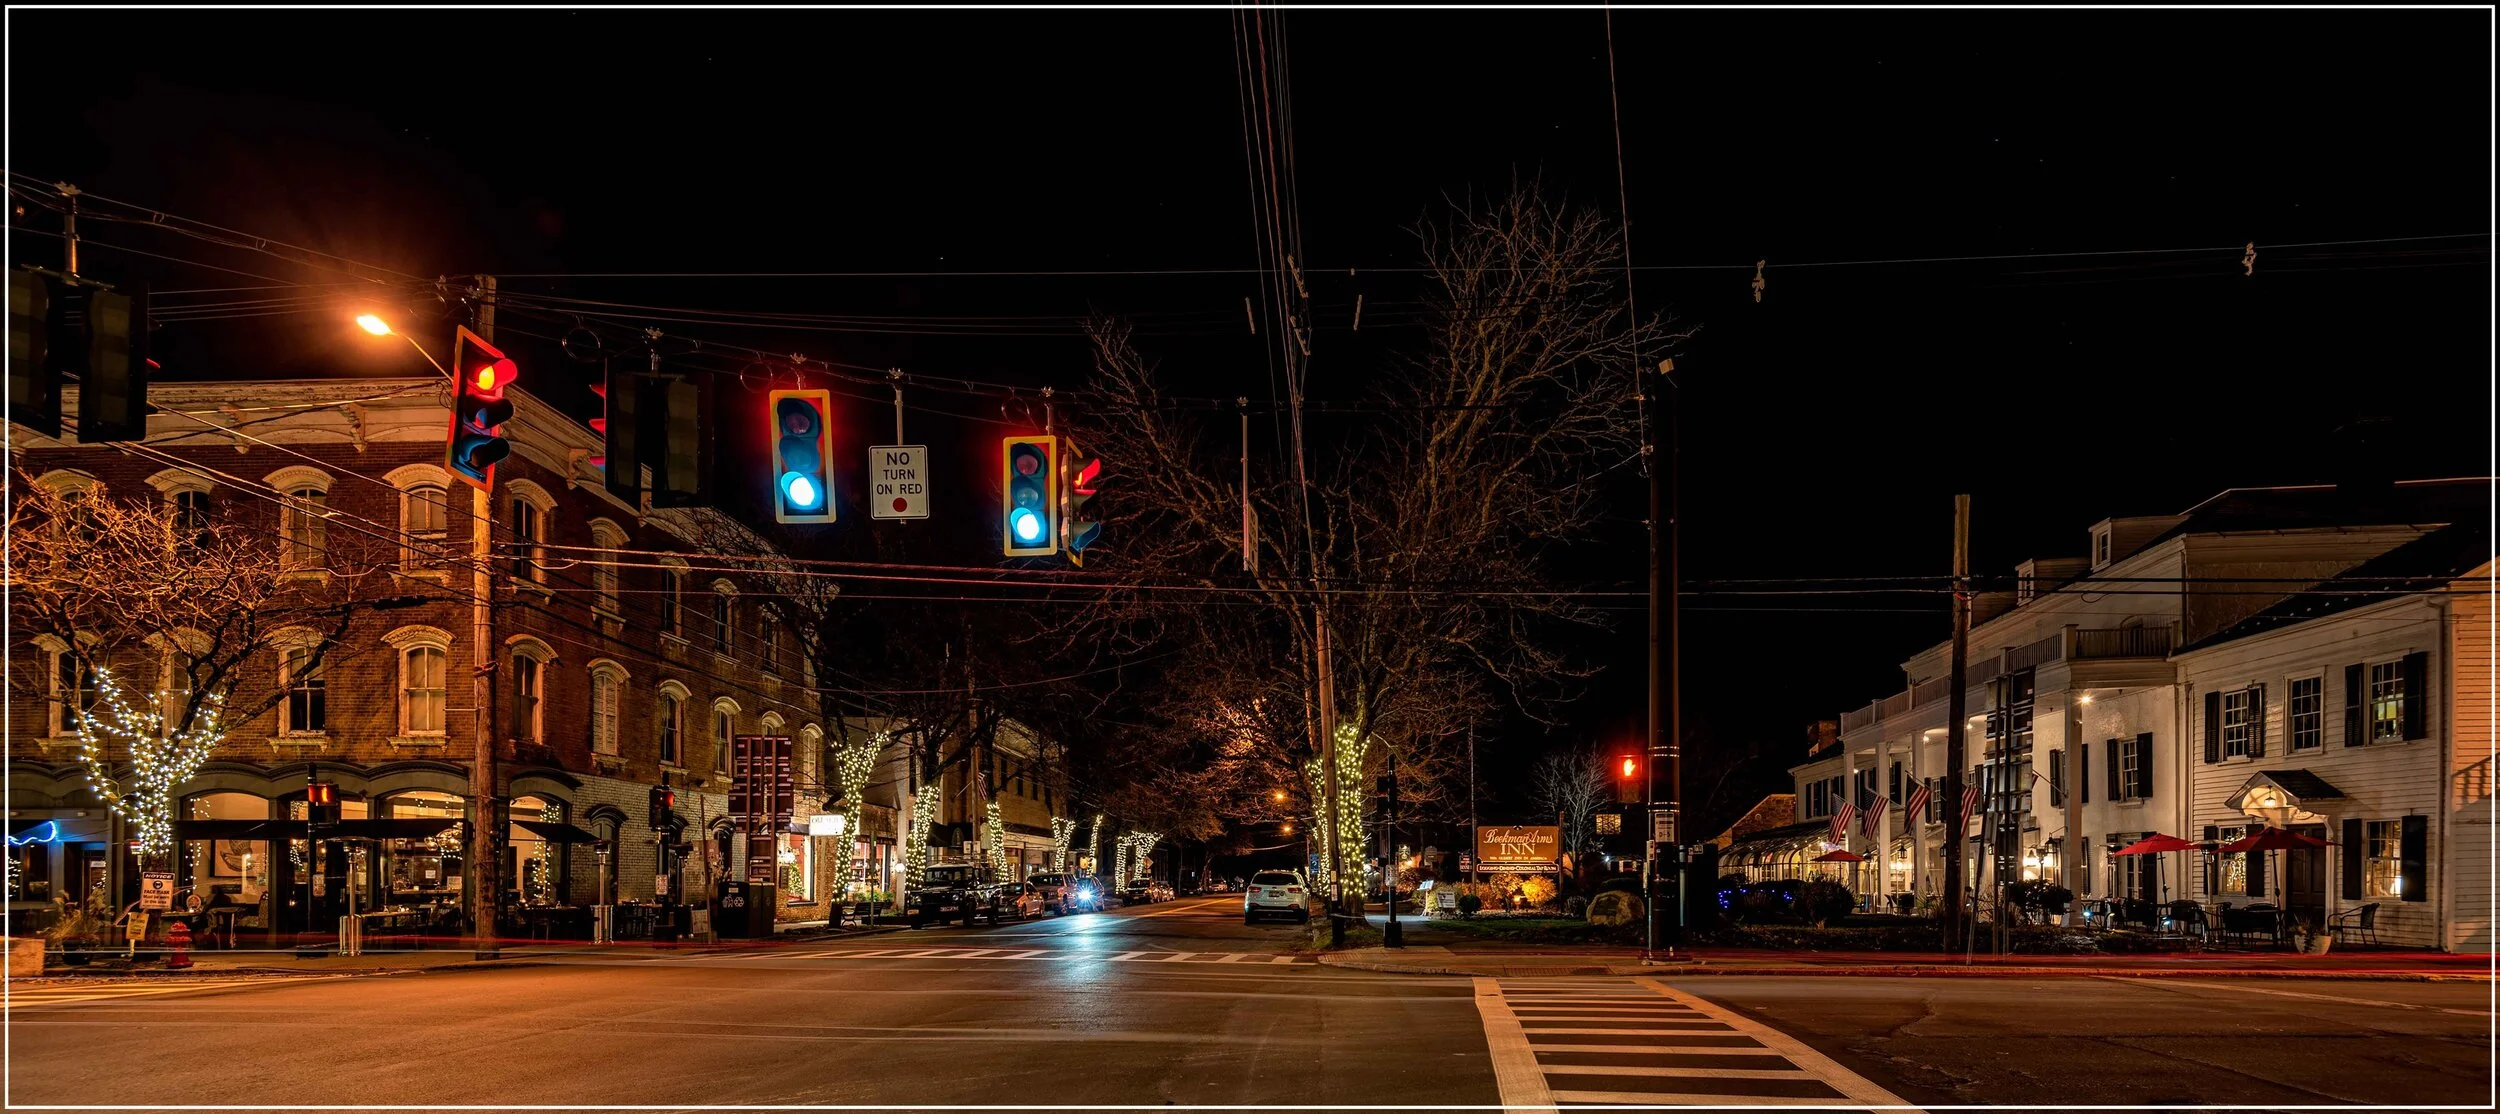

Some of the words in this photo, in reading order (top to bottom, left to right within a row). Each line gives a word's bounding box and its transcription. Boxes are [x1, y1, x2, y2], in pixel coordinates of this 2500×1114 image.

[886, 452, 910, 466] NO
[883, 469, 915, 480] TURN
[876, 484, 893, 495] ON
[900, 483, 923, 495] RED
[1483, 829, 1529, 844] Beekman
[1526, 829, 1554, 844] Arms
[1500, 843, 1536, 855] INN
